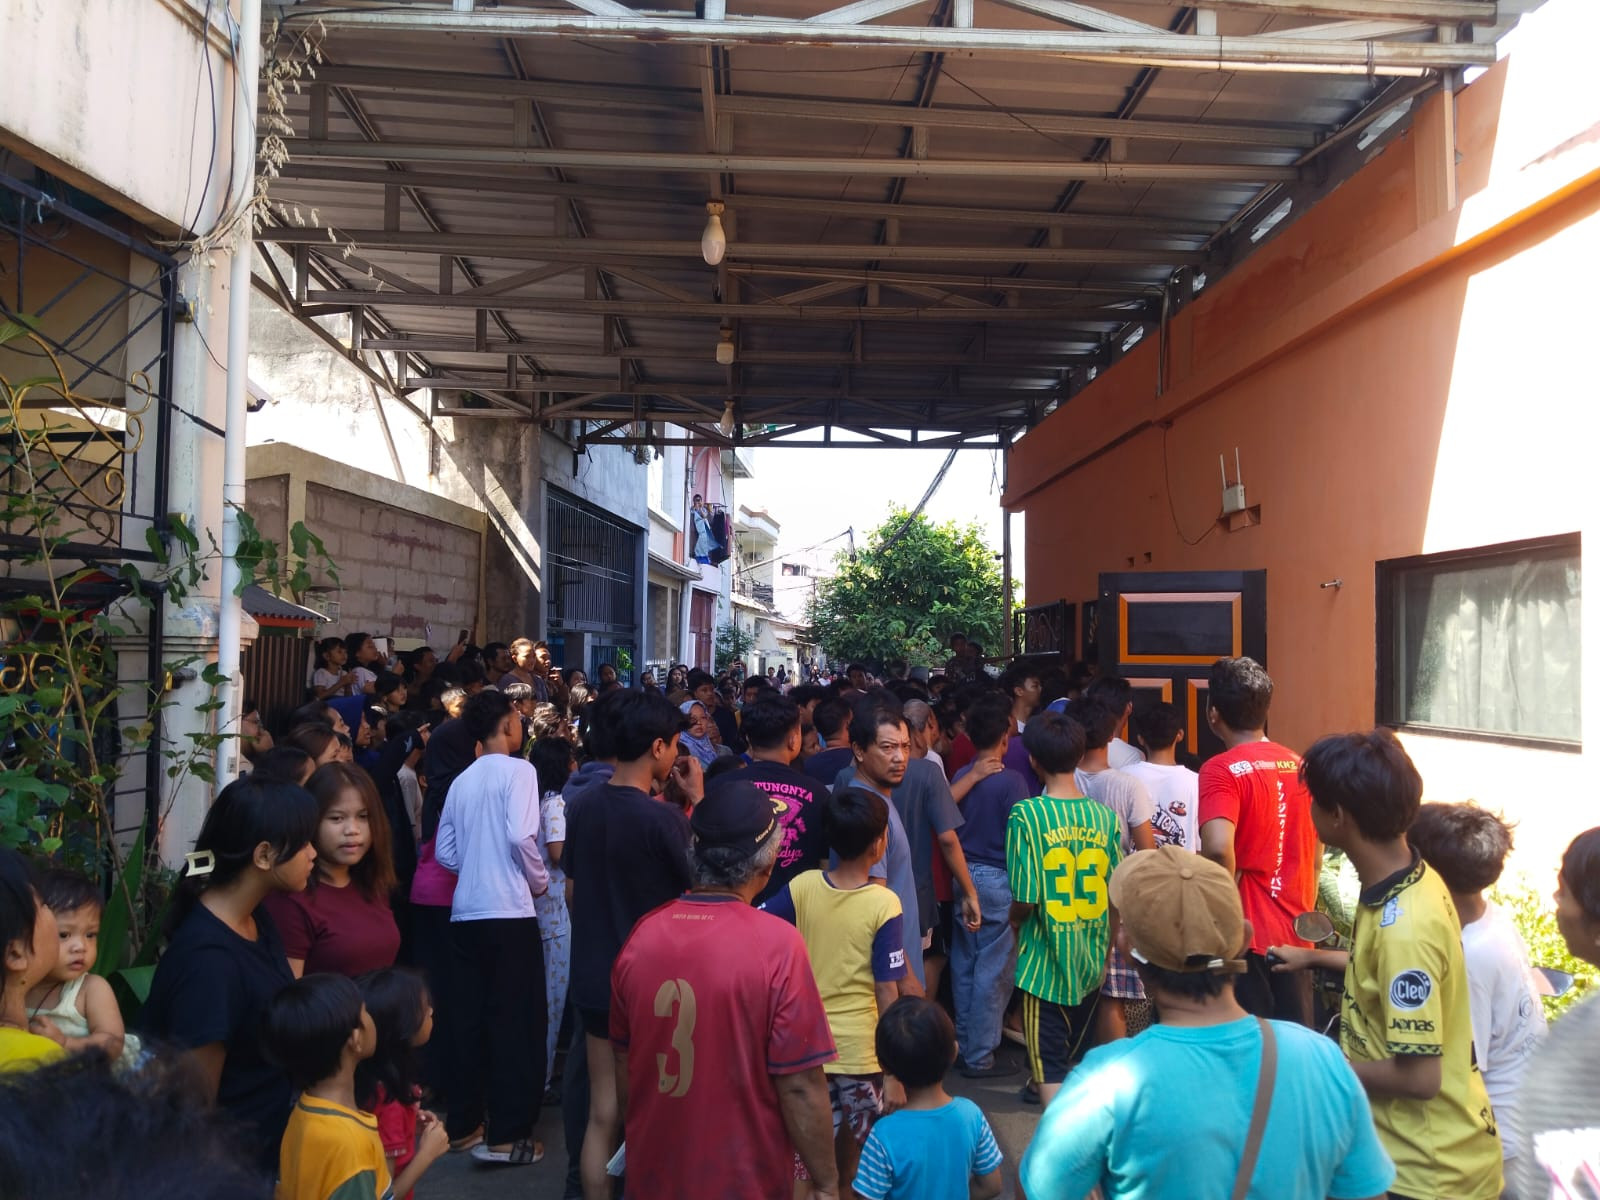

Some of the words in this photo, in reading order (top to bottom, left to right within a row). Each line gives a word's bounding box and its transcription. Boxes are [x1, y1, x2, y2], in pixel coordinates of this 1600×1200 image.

[1043, 826, 1108, 848] MOLUCCAS
[1043, 847, 1110, 922] 33
[1397, 980, 1428, 1000] Cleo
[1388, 1018, 1435, 1032] Jonas
[654, 978, 697, 1097] 3
